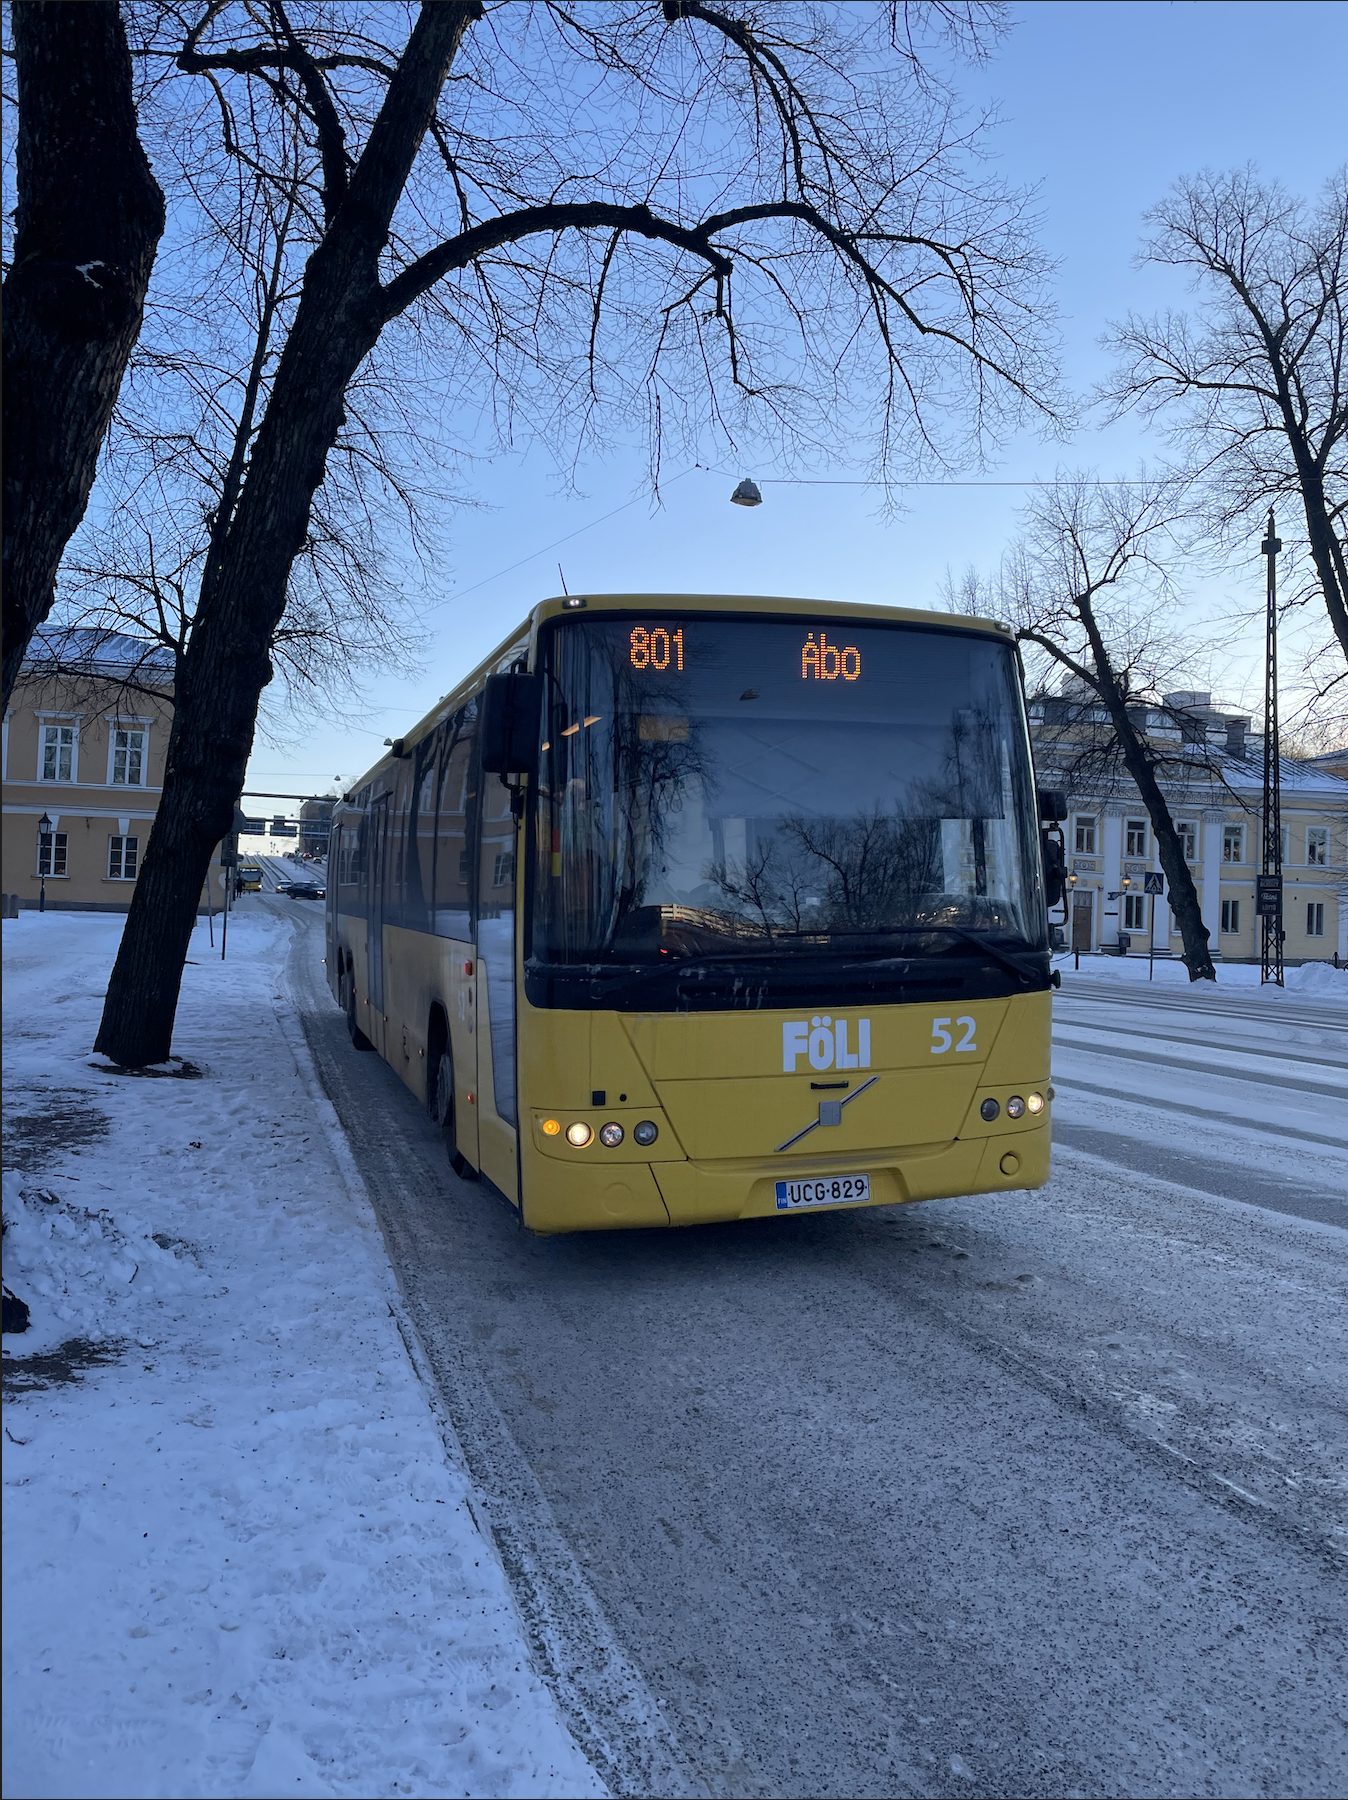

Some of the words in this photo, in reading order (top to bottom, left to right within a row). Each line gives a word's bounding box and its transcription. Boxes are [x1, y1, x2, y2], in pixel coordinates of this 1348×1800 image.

[630, 626, 684, 671] 801
[801, 632, 861, 681] Åbo
[782, 1015, 871, 1073] FÖLI
[930, 1016, 977, 1054] 52
